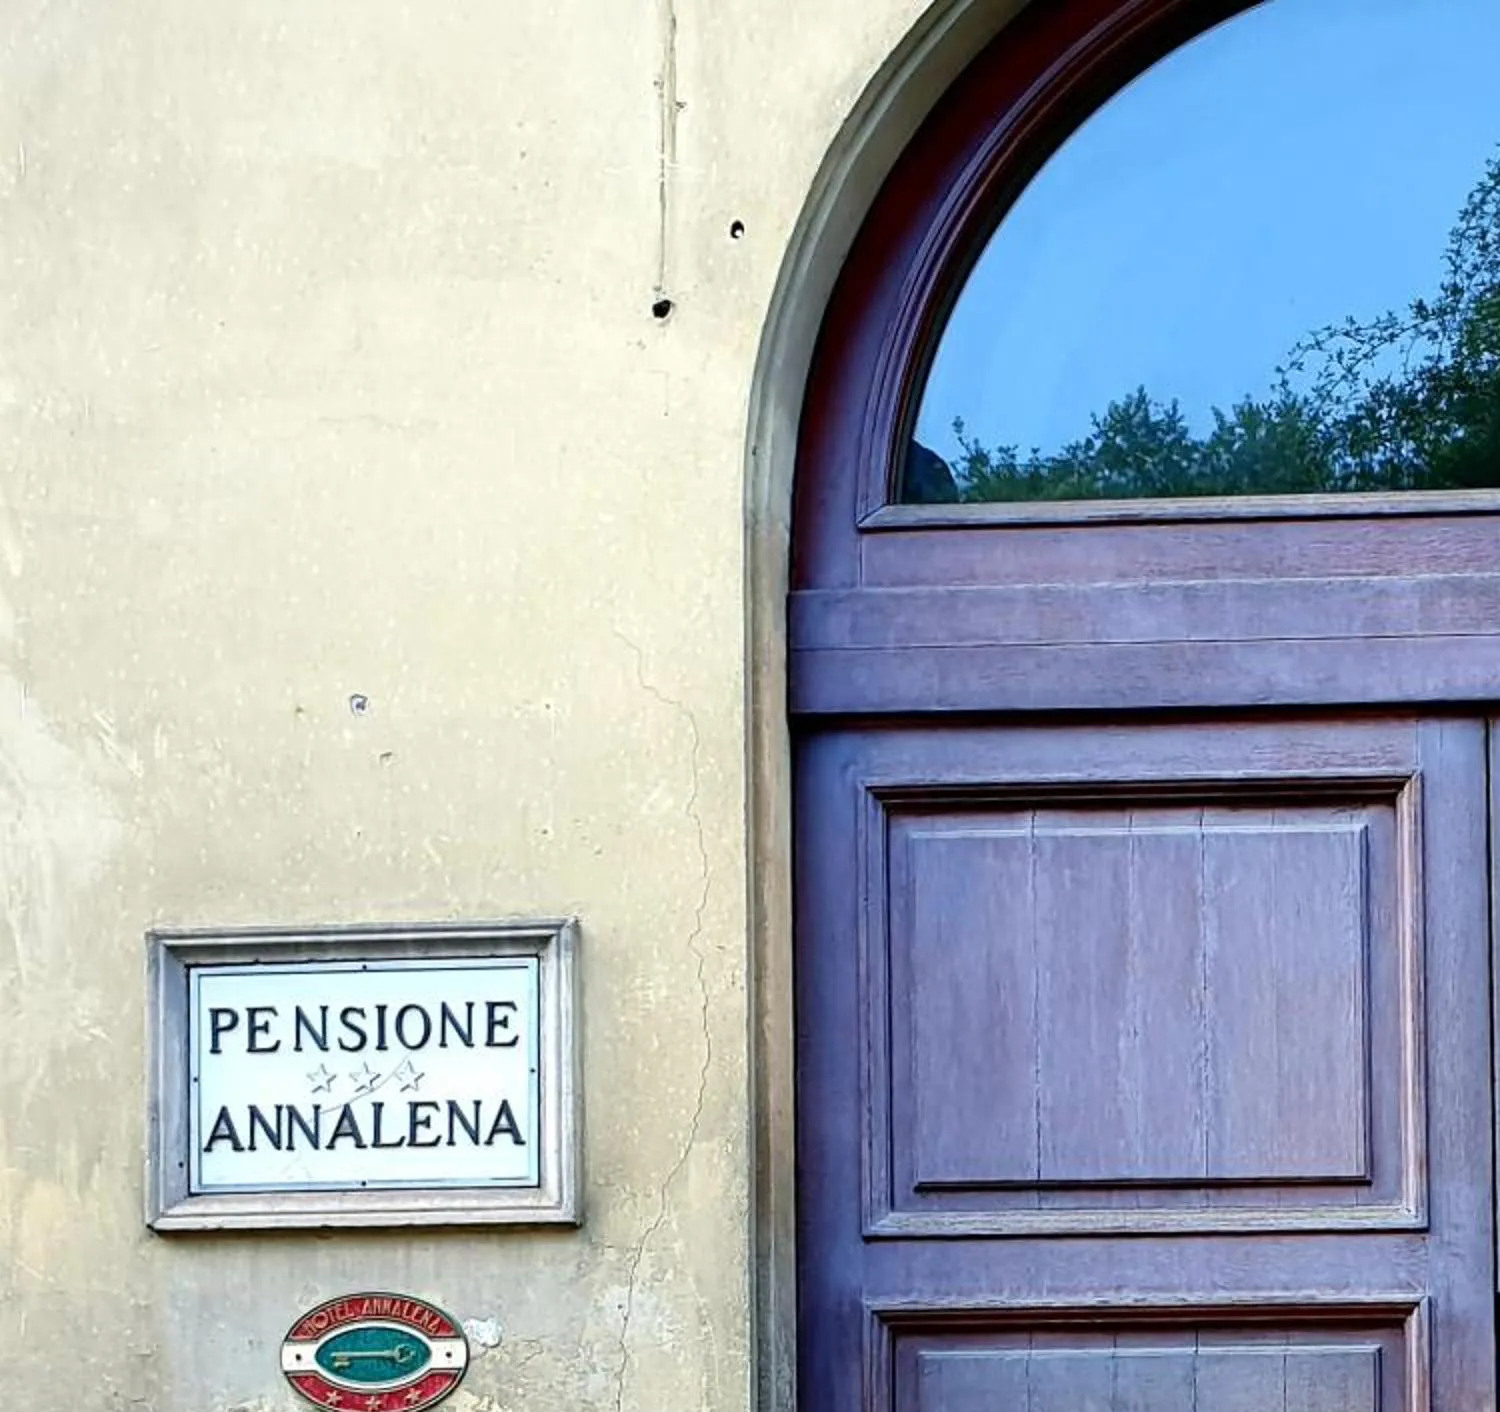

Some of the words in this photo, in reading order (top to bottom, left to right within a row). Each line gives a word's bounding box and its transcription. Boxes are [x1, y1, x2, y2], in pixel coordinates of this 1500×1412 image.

[208, 1001, 519, 1054] PENSIONE
[203, 1099, 526, 1152] ANNALENA
[302, 1302, 354, 1336] HOTEL
[361, 1298, 440, 1334] ANNALENA
